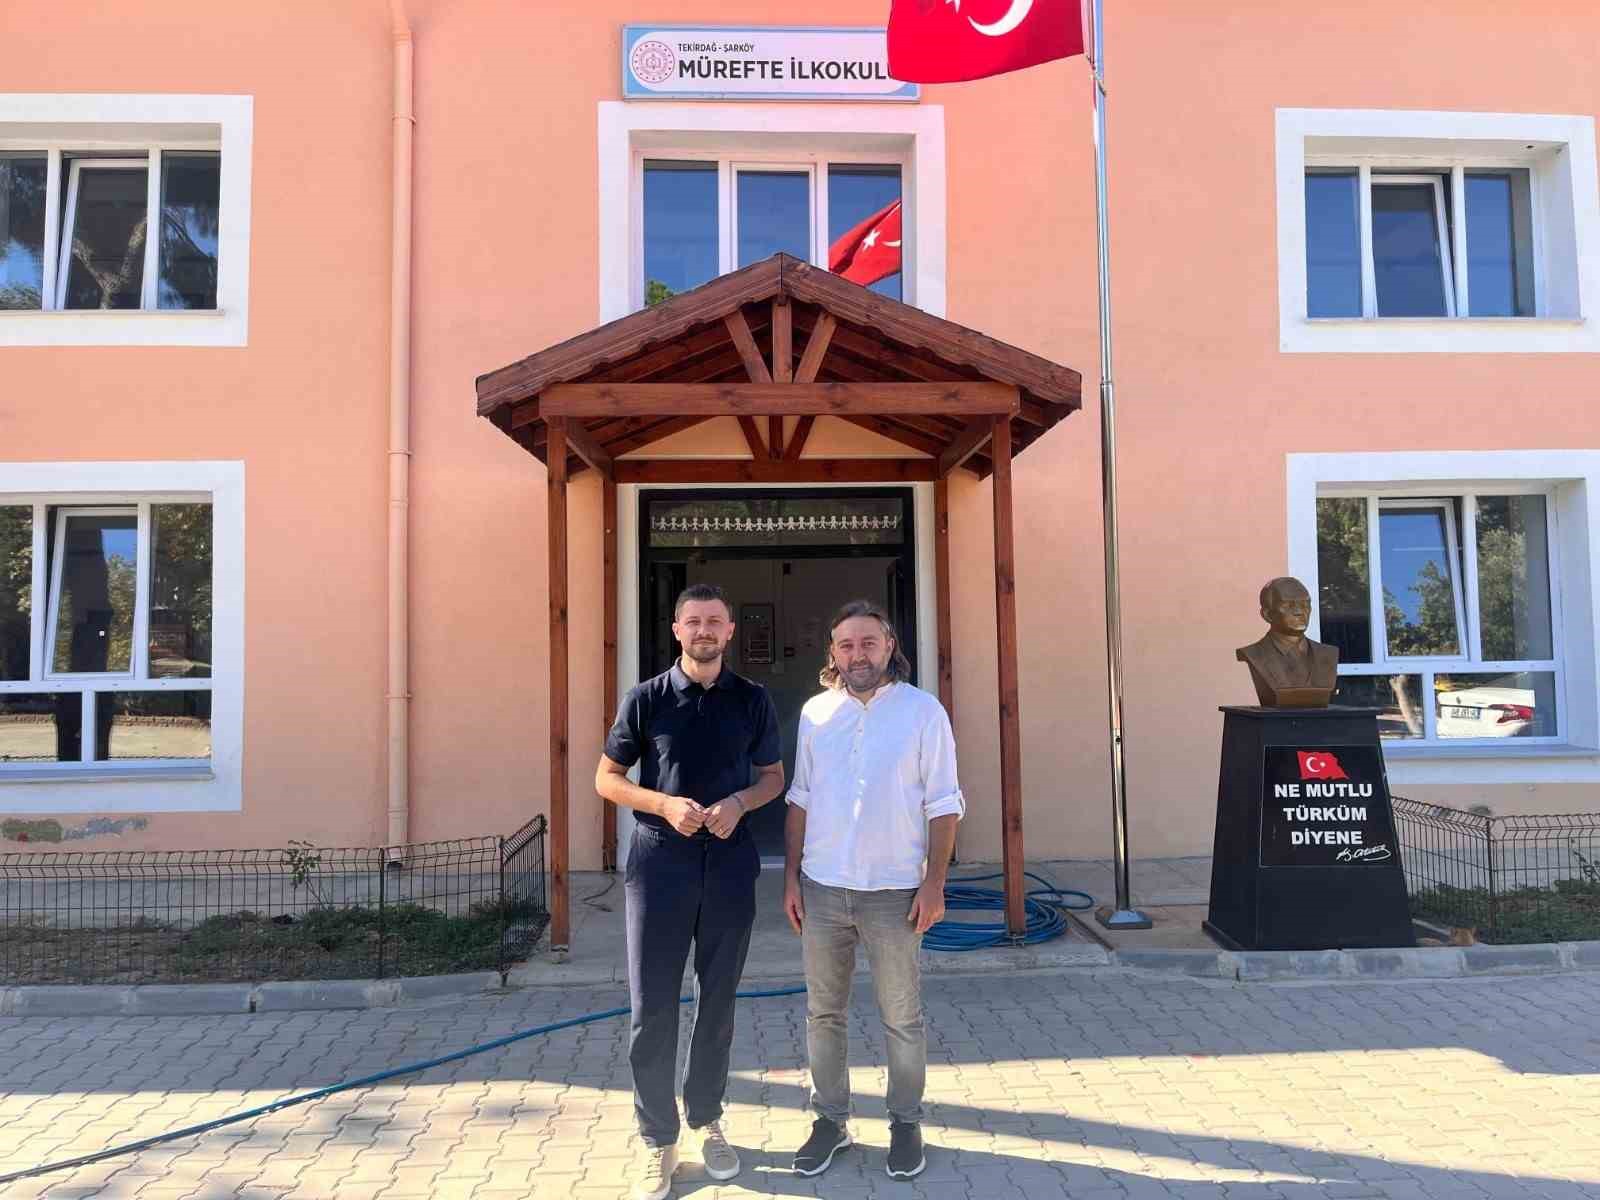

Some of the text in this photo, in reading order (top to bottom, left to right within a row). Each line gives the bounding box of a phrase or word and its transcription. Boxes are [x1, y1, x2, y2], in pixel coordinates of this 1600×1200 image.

[678, 42, 717, 52] TEKİRDAĞ
[723, 42, 754, 52] ŞARKÖY
[679, 56, 784, 79] MÜREFTE
[791, 57, 892, 80] İLKOKUL
[1274, 783, 1373, 798] NE MUTLU
[1283, 805, 1368, 821] TÜRKÜM
[1291, 827, 1363, 845] DİYENE
